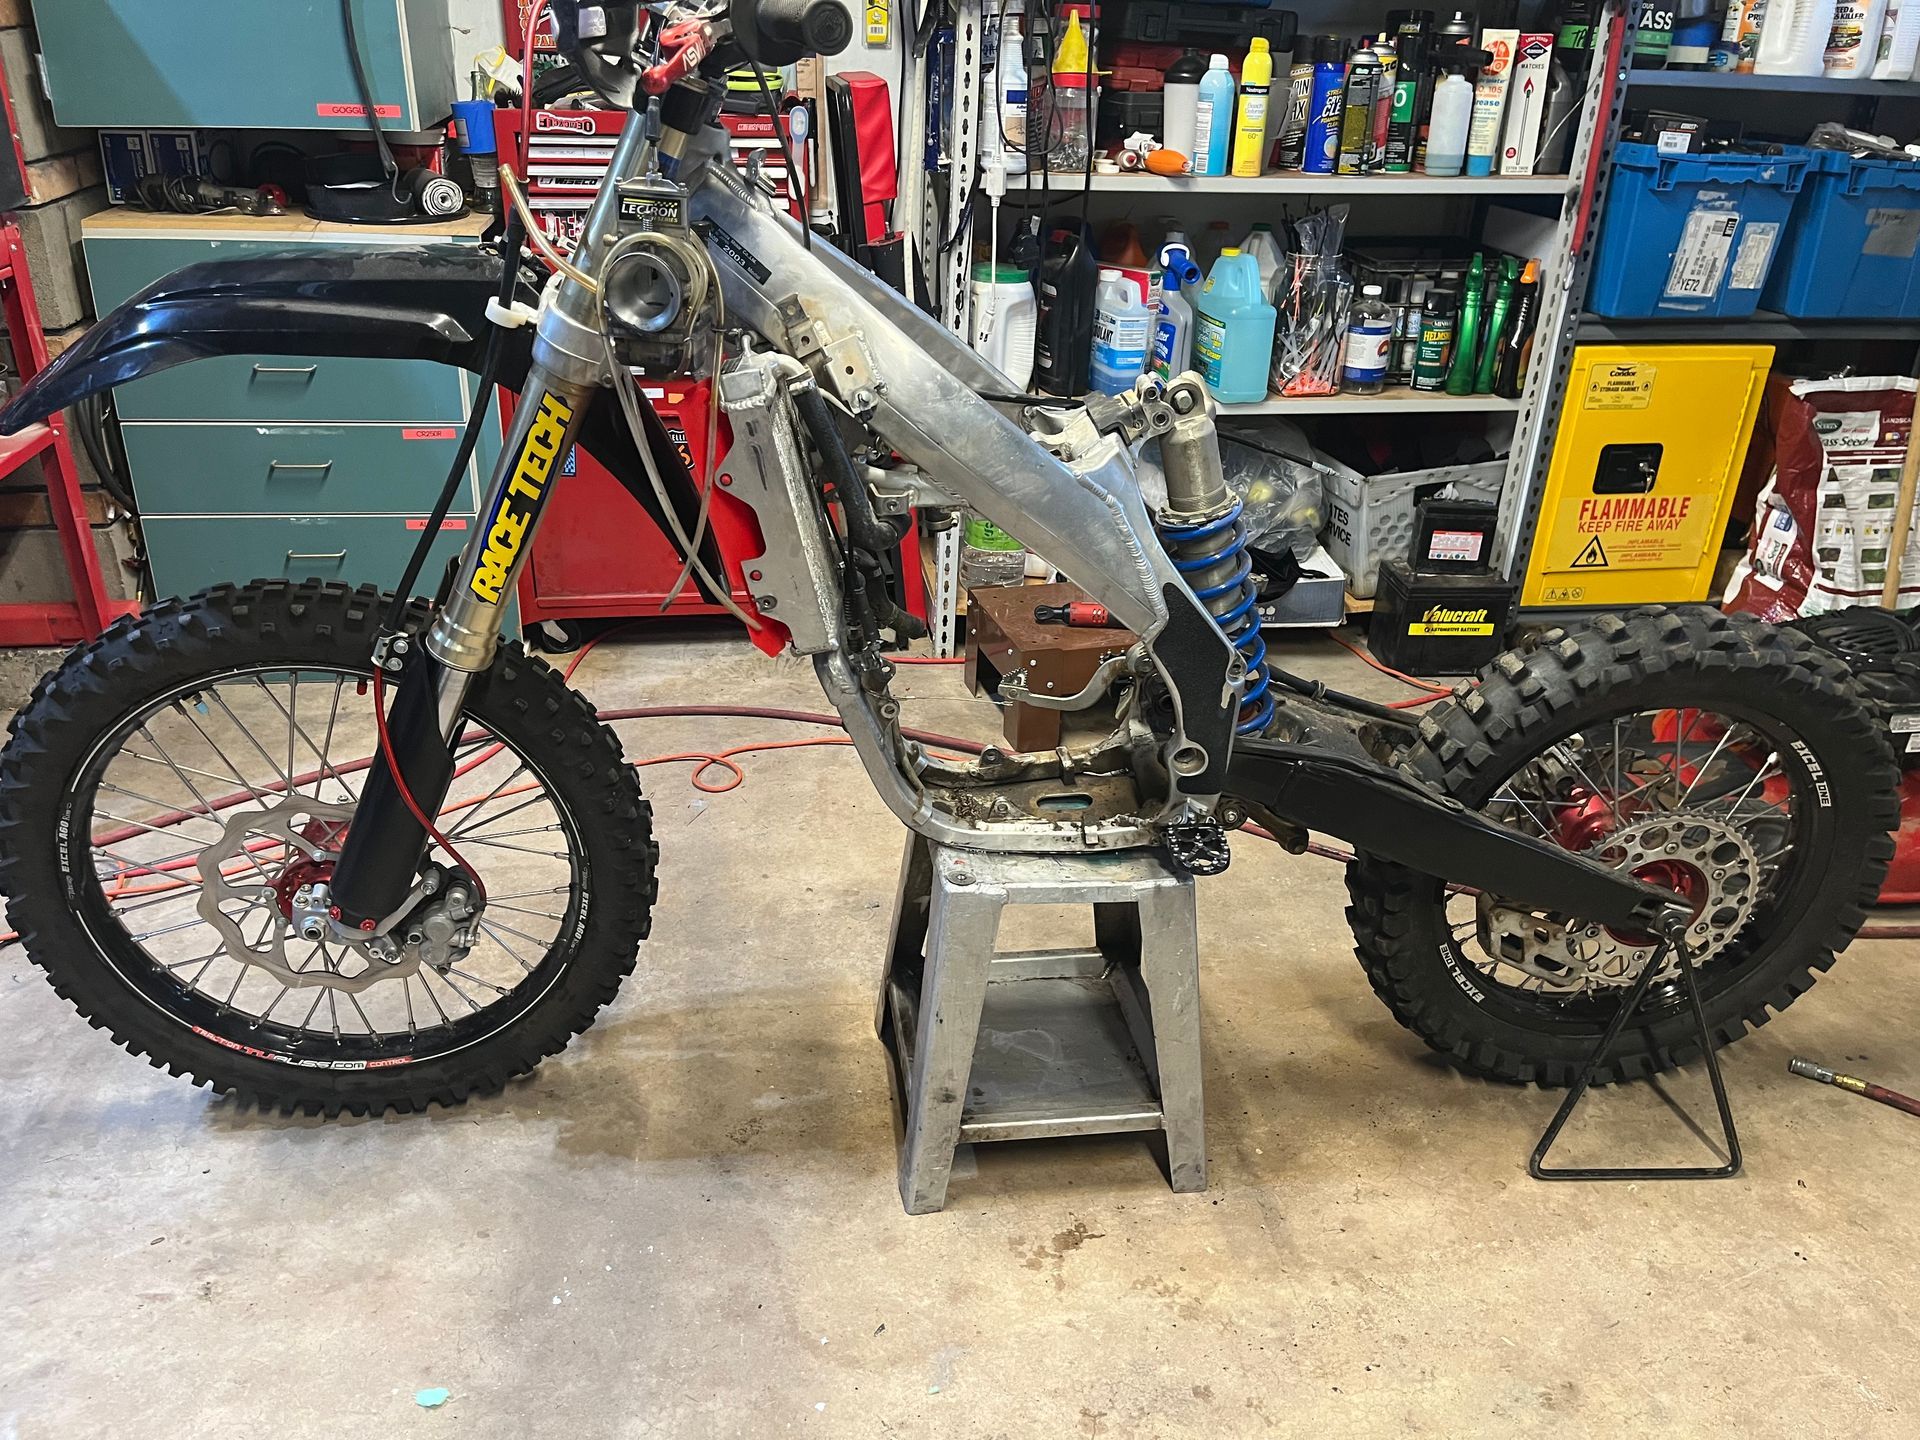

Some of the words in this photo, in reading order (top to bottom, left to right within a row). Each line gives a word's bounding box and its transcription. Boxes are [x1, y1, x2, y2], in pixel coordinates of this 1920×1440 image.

[1639, 10, 1674, 30] ASS
[554, 177, 599, 186] WISECO
[722, 244, 746, 267] 2003
[1680, 278, 1700, 292] YE72
[1839, 435, 1869, 447] Seed
[469, 497, 532, 605] RACE
[508, 389, 574, 501] TECH
[1578, 496, 1692, 521] FLAMMABLE
[1327, 520, 1352, 547] RVICE
[1577, 520, 1612, 533] KEEP
[1614, 519, 1644, 533] FIRE
[1646, 518, 1682, 531] AWAY
[1421, 604, 1488, 623] Valucraft
[1790, 740, 1823, 781] EXCEL
[1815, 780, 1832, 808] ONE
[59, 820, 69, 840] A60
[60, 841, 70, 873] EXCEL
[580, 891, 589, 921] EXCEL
[1439, 942, 1456, 969] ONE
[1452, 966, 1486, 1003] EXCEL
